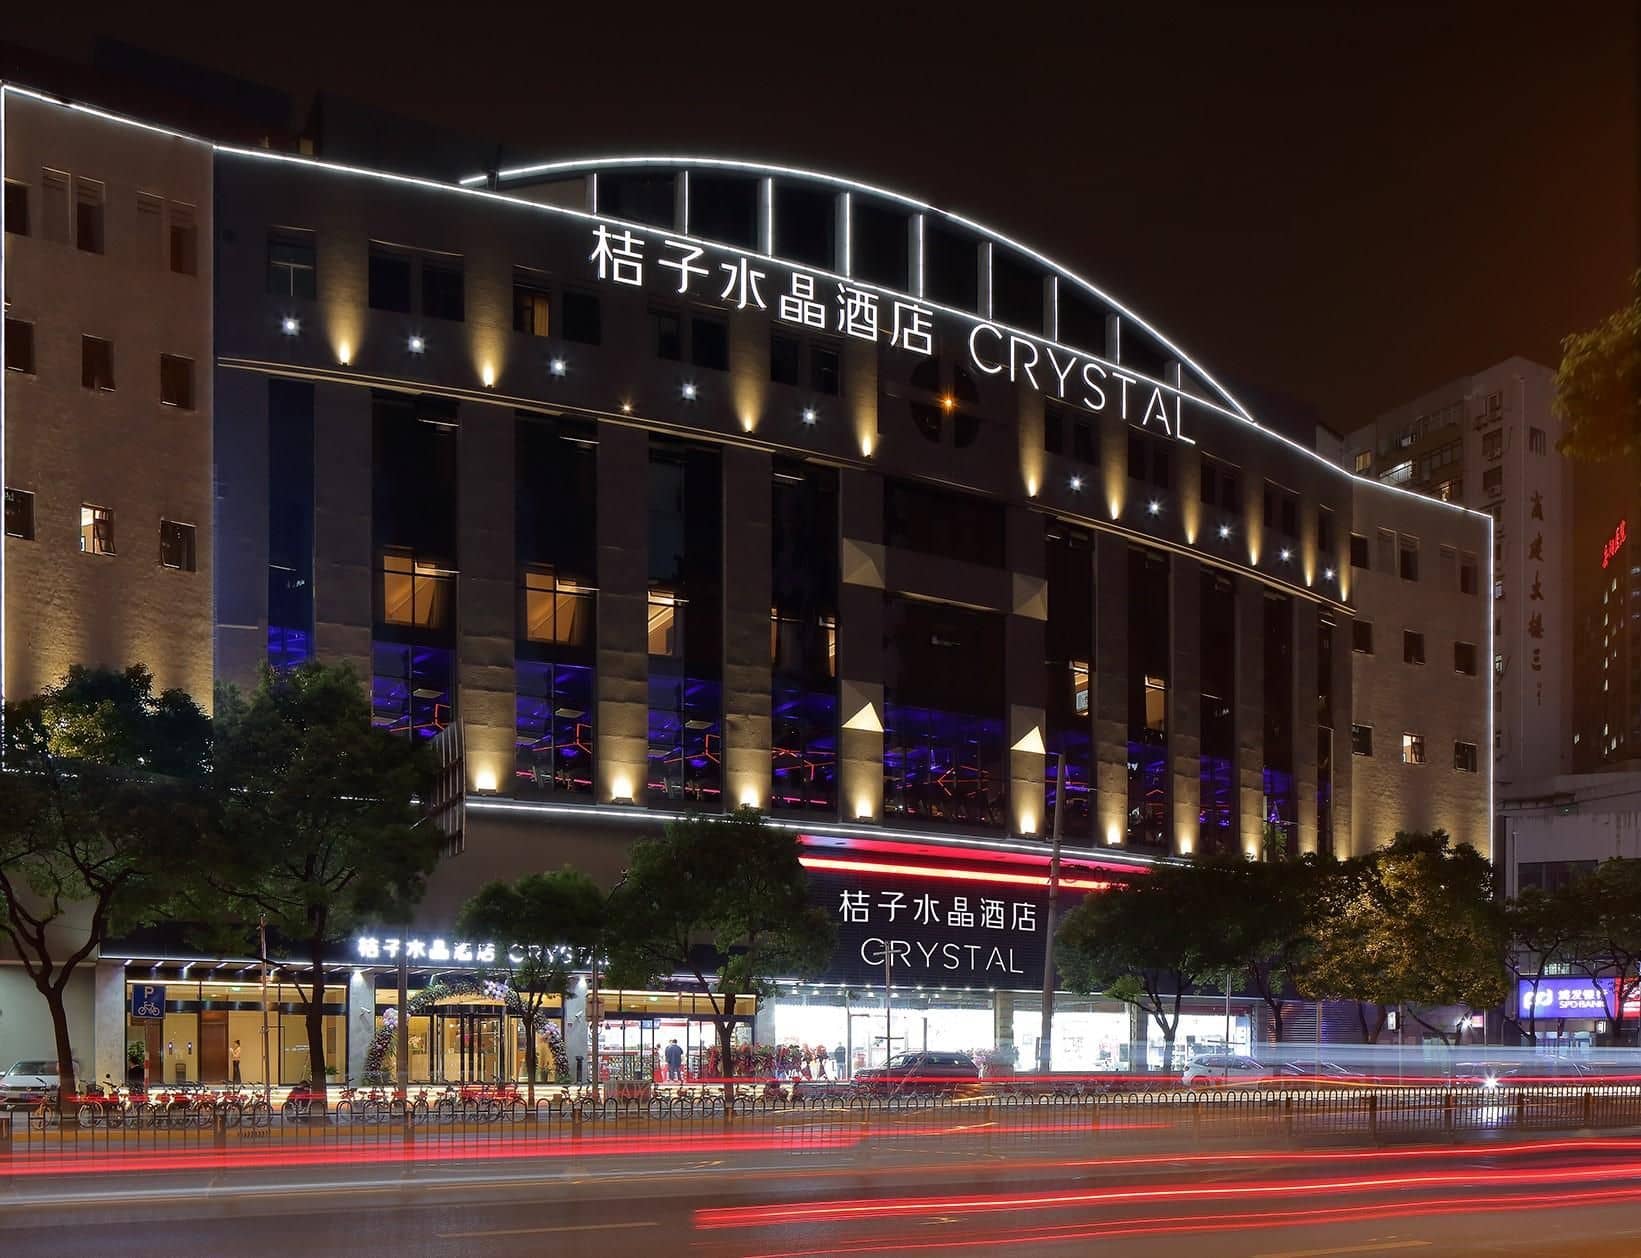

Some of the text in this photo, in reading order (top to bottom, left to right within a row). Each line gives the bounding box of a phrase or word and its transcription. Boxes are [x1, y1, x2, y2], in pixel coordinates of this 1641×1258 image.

[590, 224, 934, 357] 桔子水晶酒店
[968, 322, 1197, 446] CRYSTAL
[838, 890, 1037, 932] 桔子水晶酒店
[861, 937, 1024, 974] CRYSTAL
[144, 986, 155, 999] P
